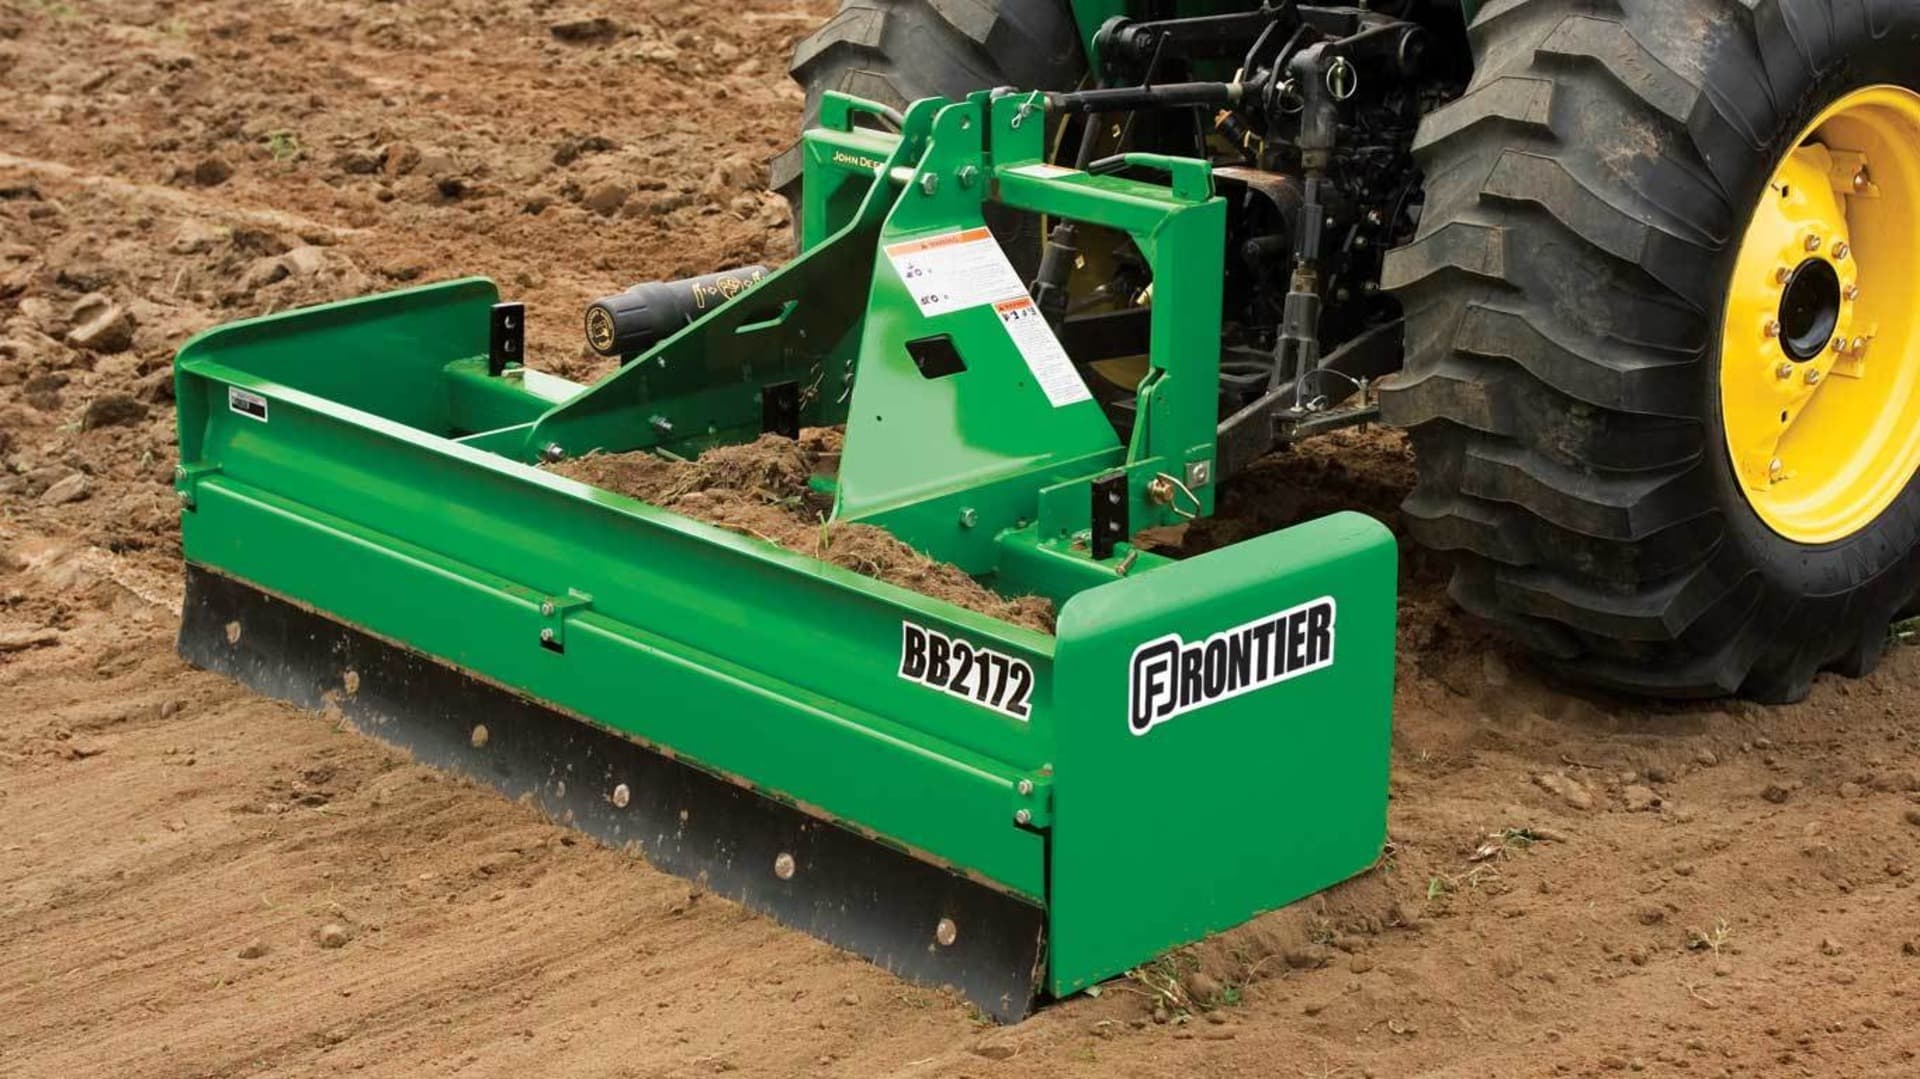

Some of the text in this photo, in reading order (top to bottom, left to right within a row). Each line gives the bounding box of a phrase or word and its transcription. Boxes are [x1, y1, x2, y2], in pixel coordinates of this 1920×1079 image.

[833, 151, 858, 166] JOHN
[901, 624, 1032, 718] BB2172
[1132, 602, 1333, 730] FRONTIER
